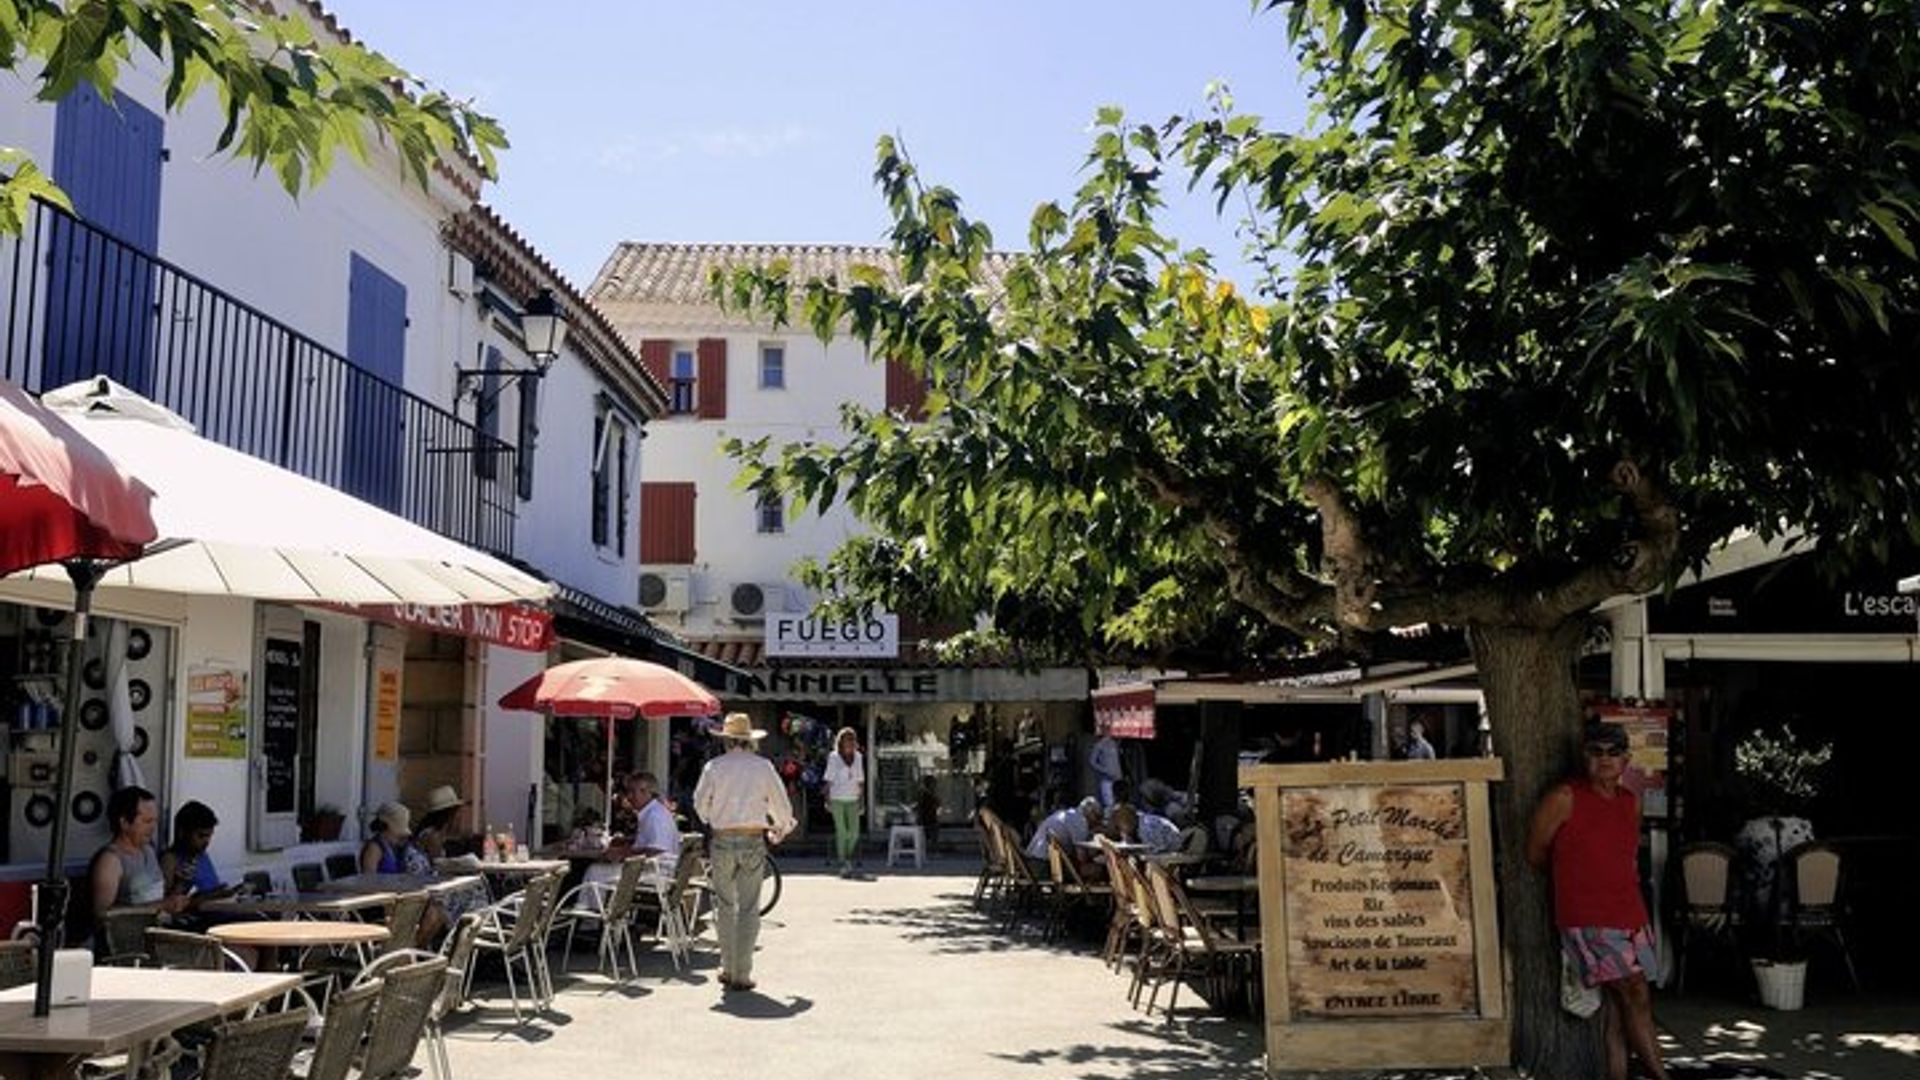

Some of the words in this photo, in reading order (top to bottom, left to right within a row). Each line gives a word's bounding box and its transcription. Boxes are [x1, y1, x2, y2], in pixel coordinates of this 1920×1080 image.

[472, 602, 502, 640] NON
[507, 615, 543, 646] STOP
[778, 618, 885, 641] FUEGO
[1331, 807, 1380, 832] Petit
[1308, 846, 1328, 865] de
[1338, 842, 1433, 870] Camargue
[1312, 878, 1367, 893] Produits
[1323, 915, 1351, 929] vins
[1355, 913, 1379, 928] des
[1382, 912, 1426, 928] sables
[1374, 935, 1391, 949] de
[1328, 957, 1349, 972] Art
[1353, 956, 1371, 972] de
[1375, 955, 1388, 971] la
[1391, 954, 1427, 971] table
